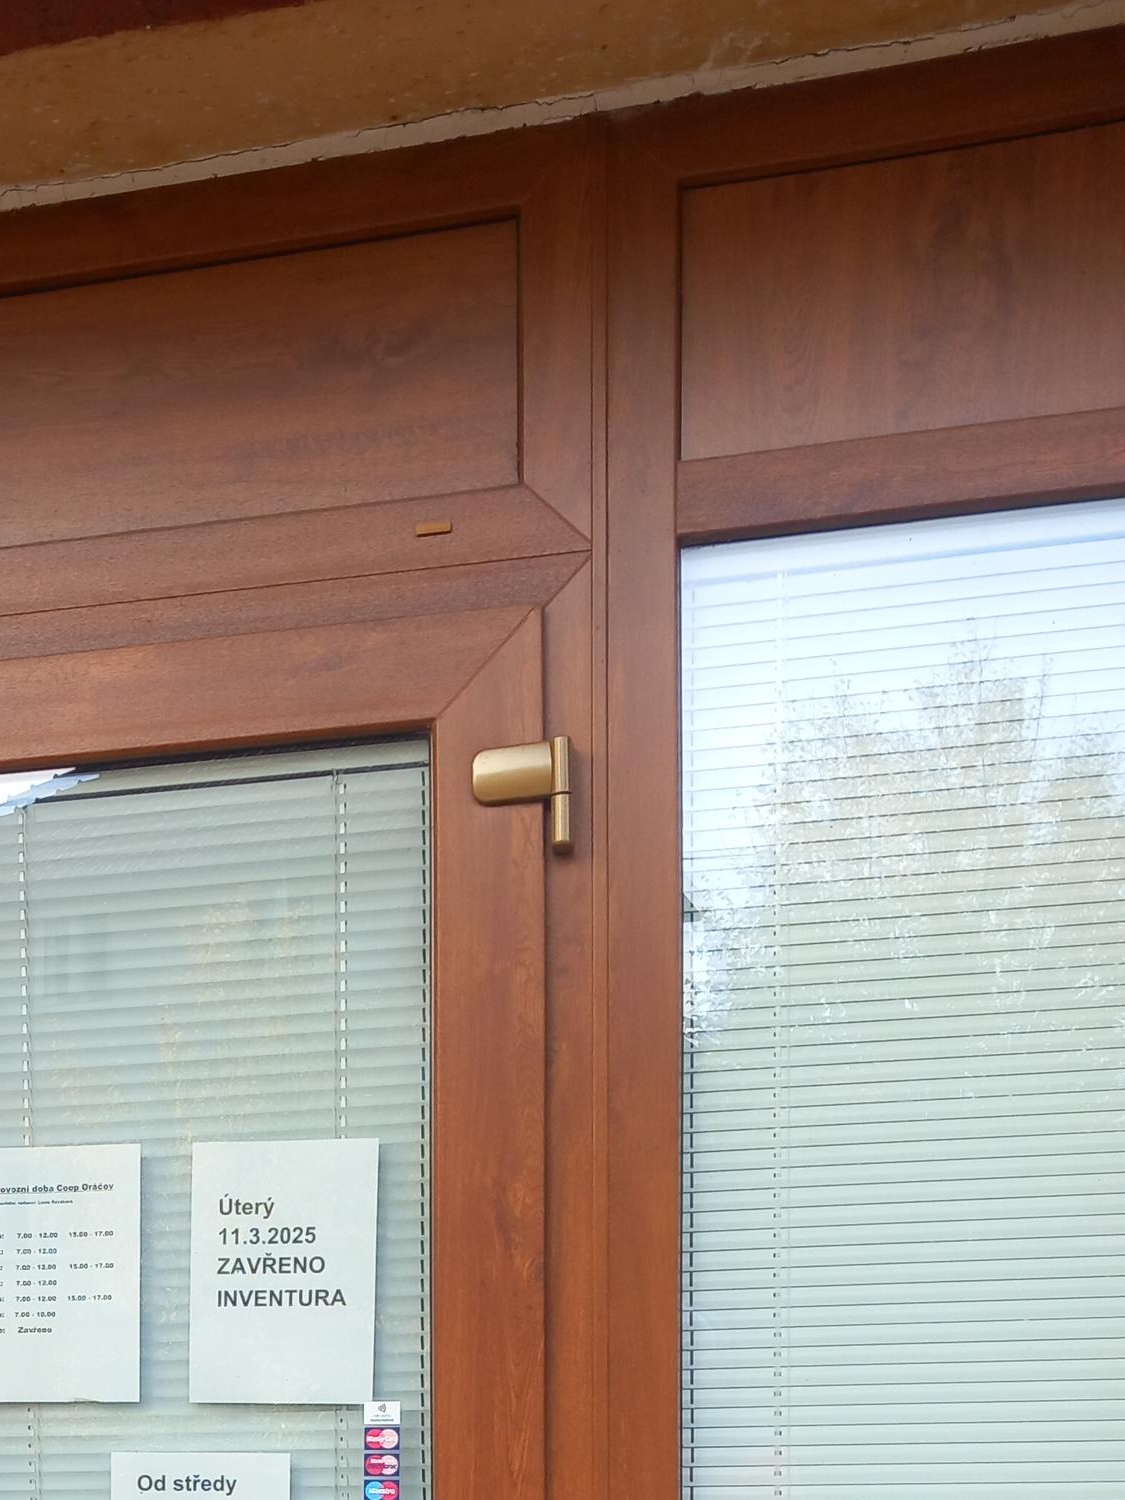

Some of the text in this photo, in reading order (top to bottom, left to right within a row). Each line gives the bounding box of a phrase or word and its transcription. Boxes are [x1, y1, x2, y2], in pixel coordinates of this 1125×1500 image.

[32, 1184, 54, 1193] doba
[56, 1184, 79, 1192] Coop
[81, 1182, 114, 1191] Oráčov
[219, 1193, 275, 1220] Úterý
[218, 1226, 316, 1245] 11.3.2025
[217, 1252, 326, 1275] ZAVŘENO
[217, 1288, 347, 1307] INVENTURA
[17, 1326, 52, 1334] Zavřeno
[137, 1474, 237, 1496] Od středy
